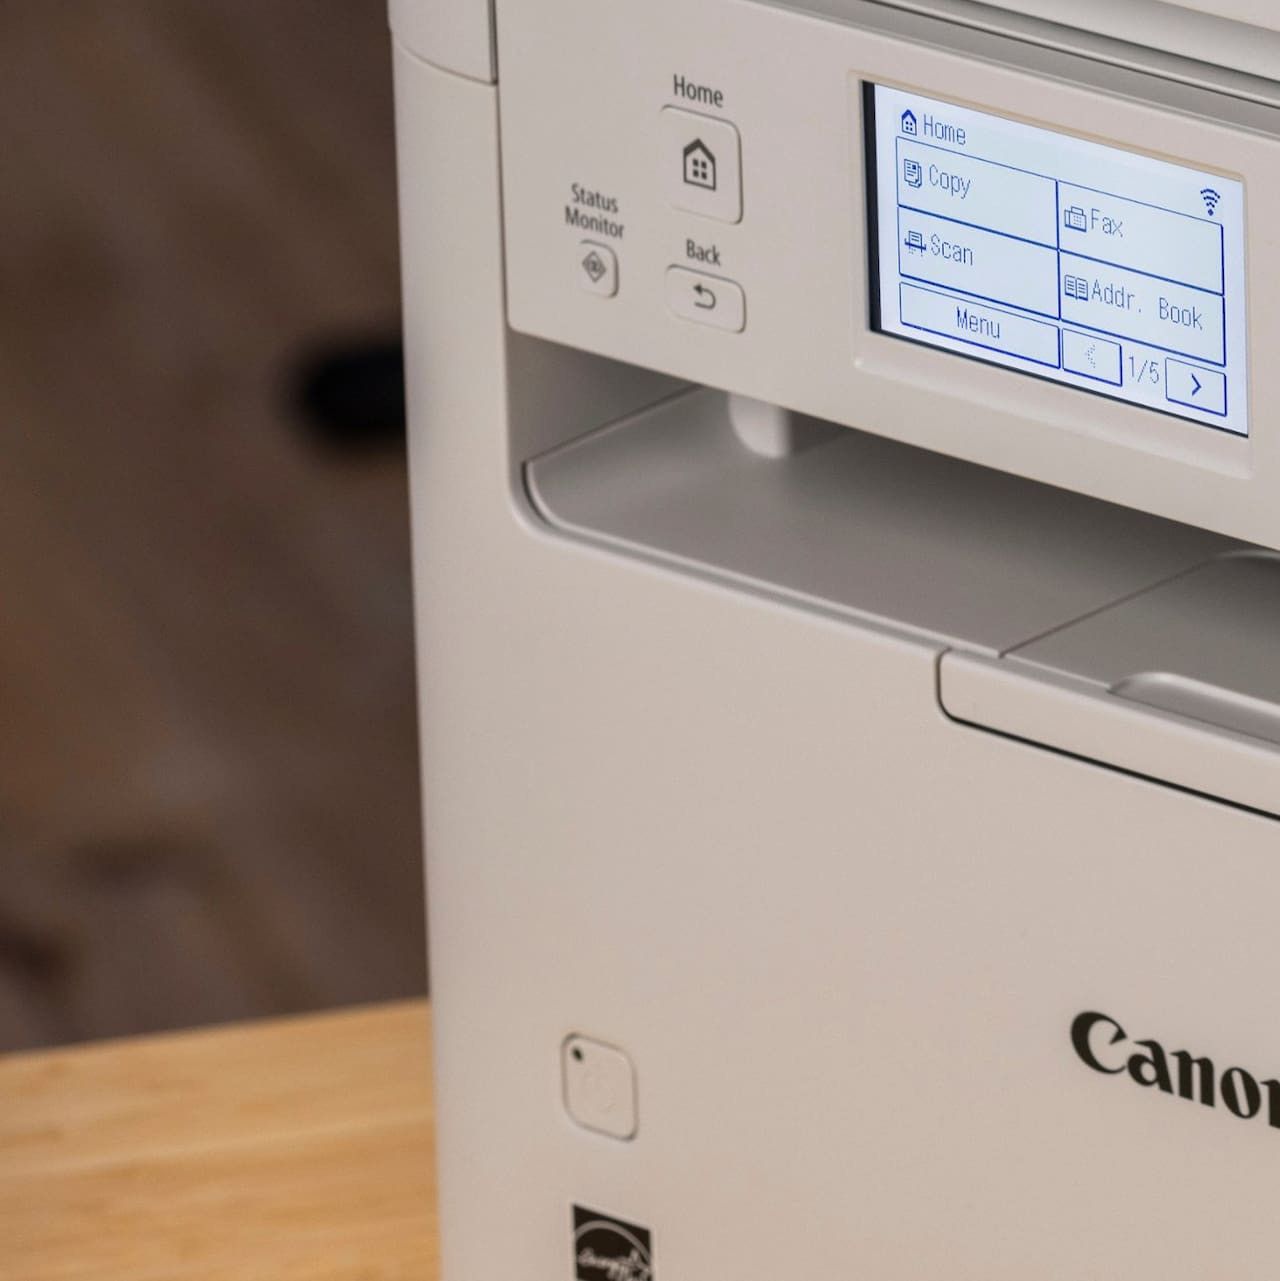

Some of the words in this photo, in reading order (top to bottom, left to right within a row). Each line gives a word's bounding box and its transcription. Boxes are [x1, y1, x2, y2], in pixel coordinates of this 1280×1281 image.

[673, 74, 724, 108] Home
[922, 114, 966, 147] Home
[571, 183, 619, 213] Status
[929, 164, 971, 200] Copy
[564, 206, 625, 240] Monitor
[1090, 207, 1124, 238] Fax
[686, 238, 721, 266] Back
[930, 233, 973, 266] Scan
[1091, 279, 1142, 313] Addr.
[1159, 297, 1203, 330] Book
[955, 305, 1001, 339] Menu
[1128, 355, 1160, 384] 1/5
